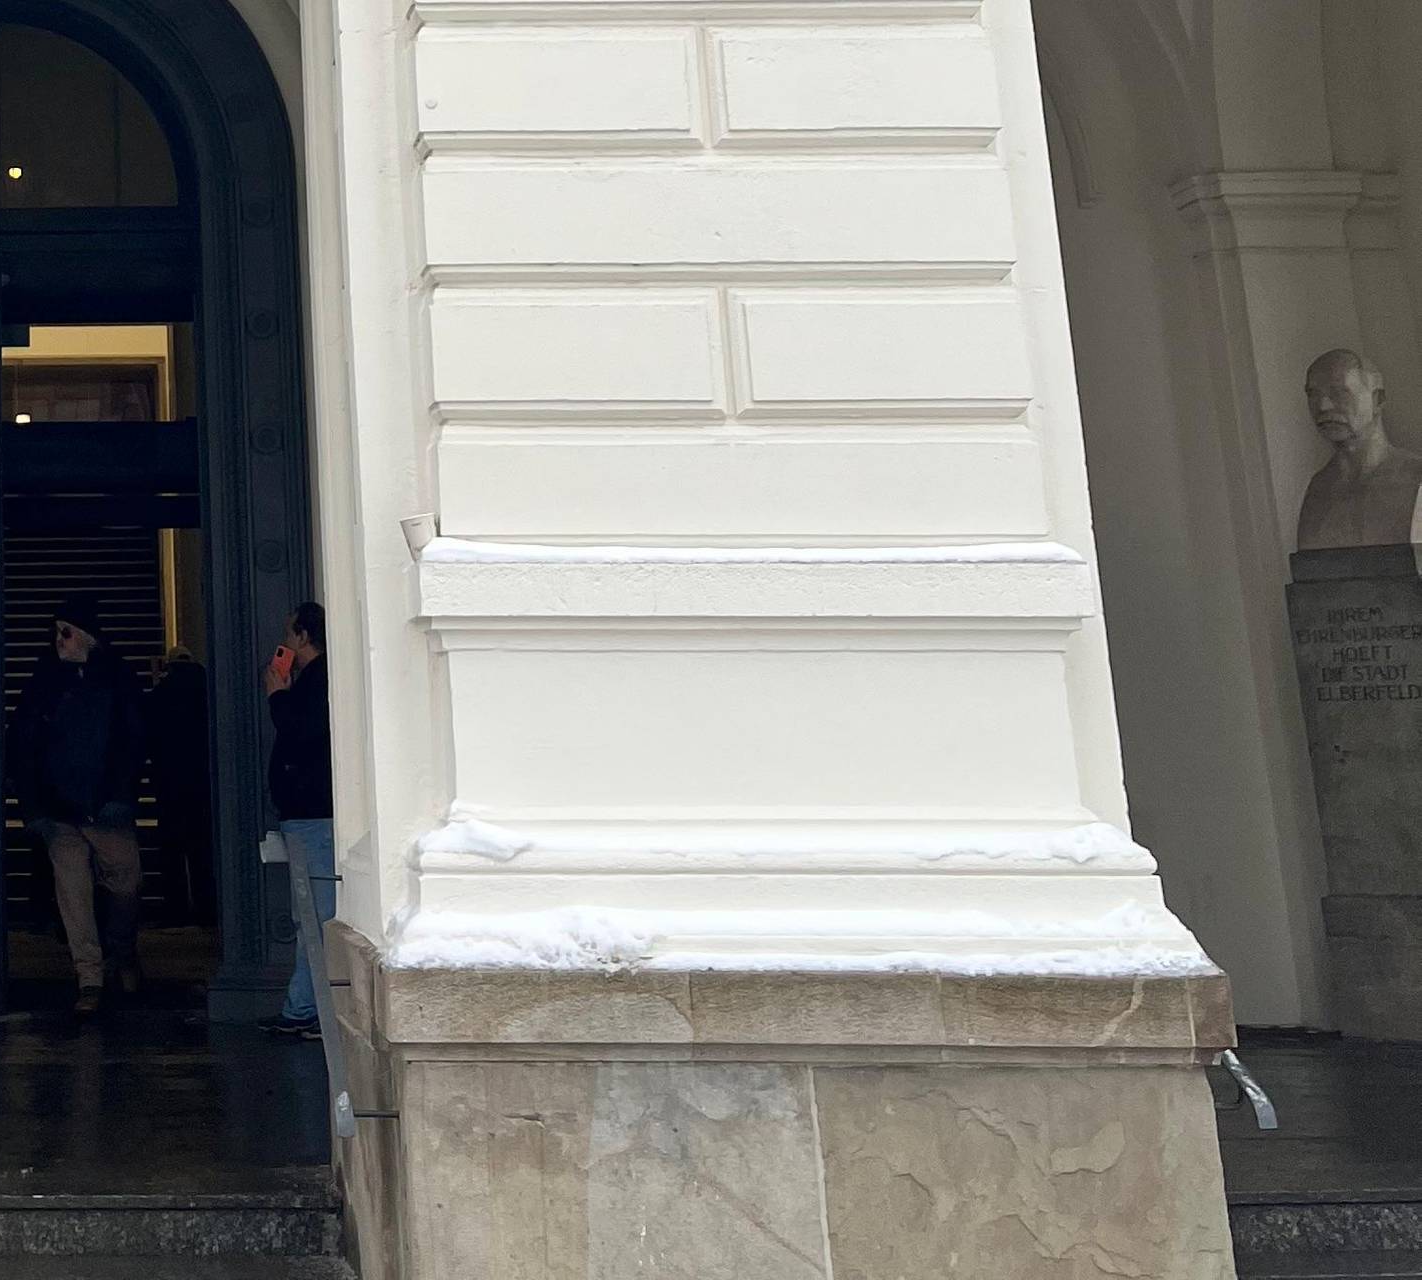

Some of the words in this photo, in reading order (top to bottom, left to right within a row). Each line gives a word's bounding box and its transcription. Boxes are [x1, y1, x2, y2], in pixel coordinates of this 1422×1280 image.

[1327, 607, 1384, 624] IHREM
[1321, 666, 1345, 683] DIE
[1352, 664, 1407, 681] STADT
[1316, 684, 1422, 702] ELBERFELD
